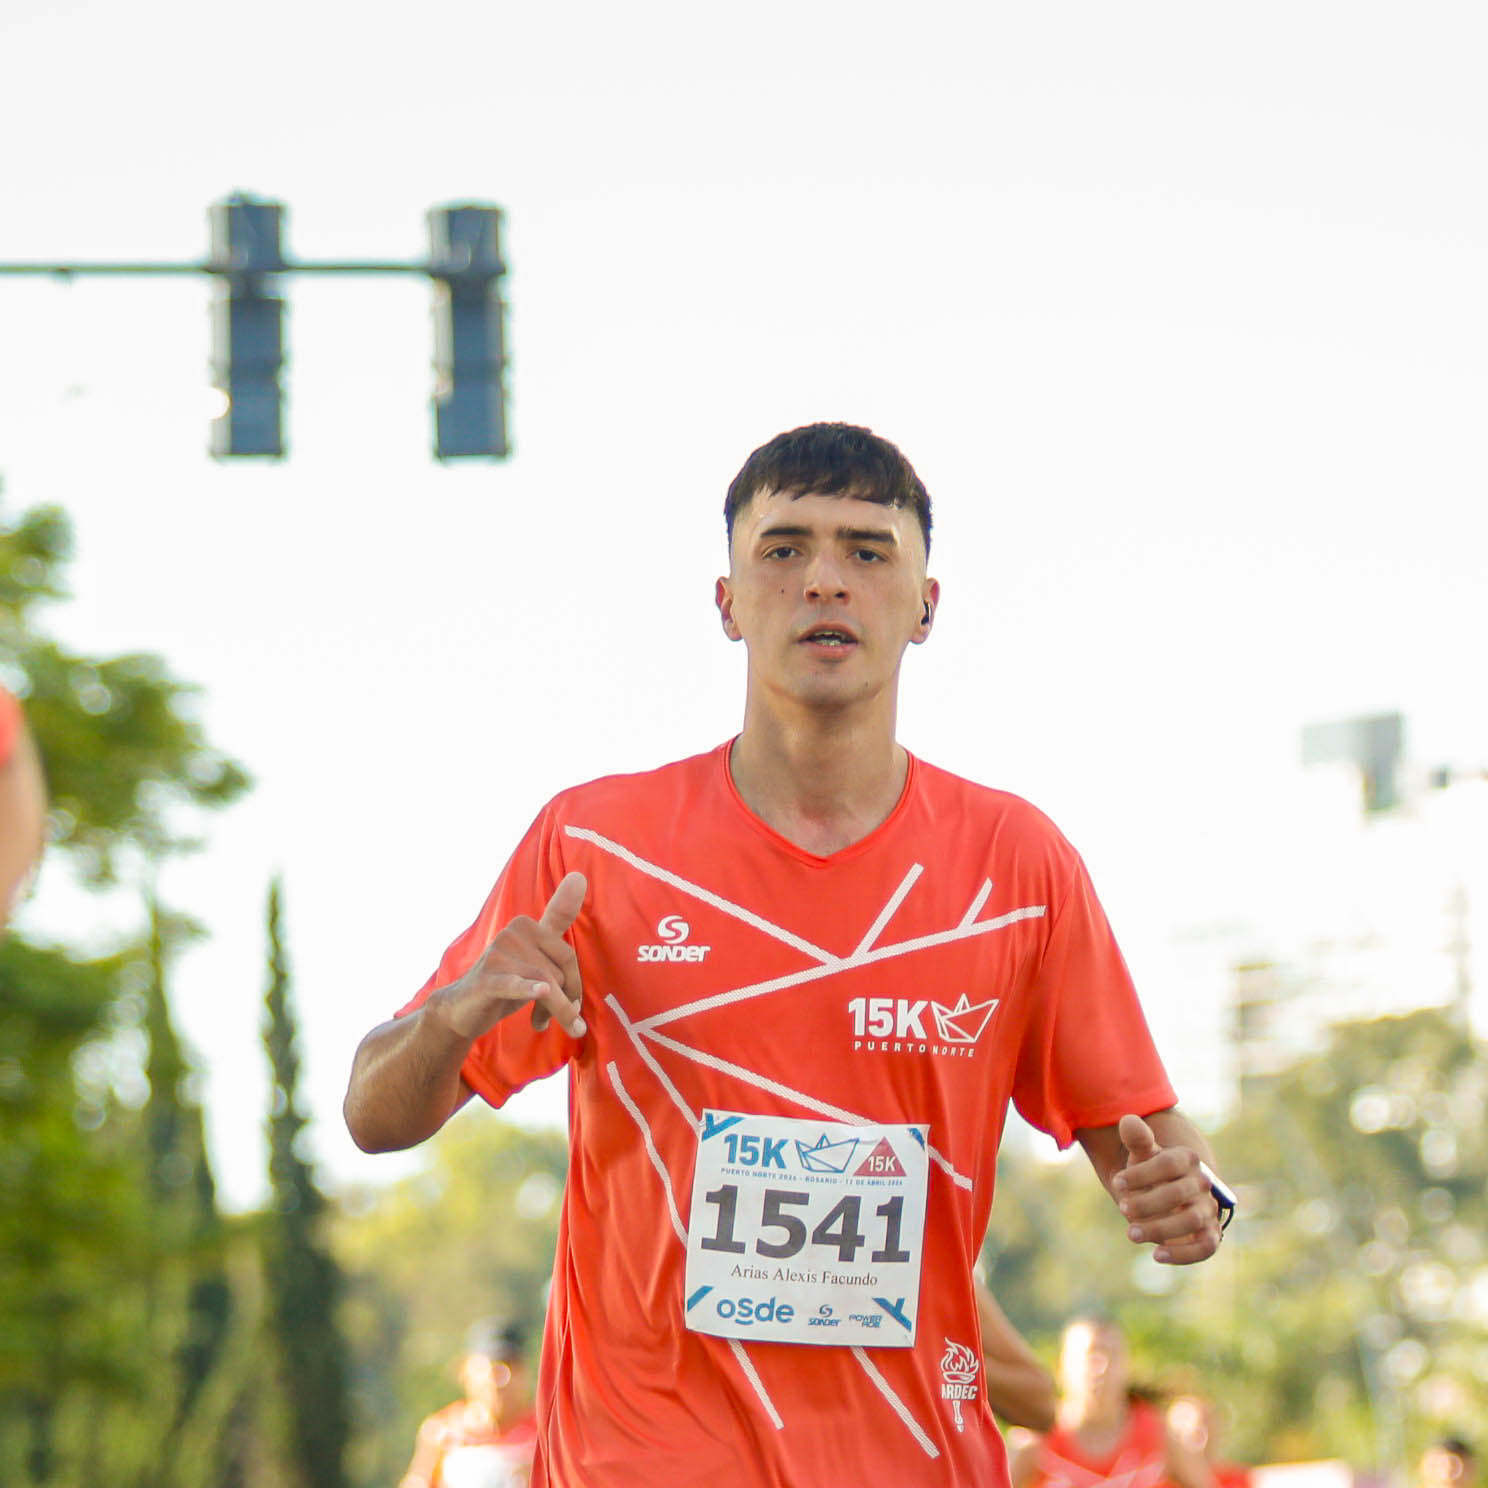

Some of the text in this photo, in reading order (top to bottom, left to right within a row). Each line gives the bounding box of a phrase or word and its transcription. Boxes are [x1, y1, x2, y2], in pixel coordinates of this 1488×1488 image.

[848, 997, 929, 1039] 15K
[854, 1041, 975, 1057] PUERTO NORTE
[724, 1133, 789, 1169] 15K
[867, 1155, 896, 1172] 15K
[720, 1167, 750, 1177] PUERTO
[752, 1170, 777, 1180] NORTE
[700, 1184, 910, 1263] 1541
[730, 1263, 878, 1287] Arias Alexis Facundo
[716, 1296, 795, 1325] osde
